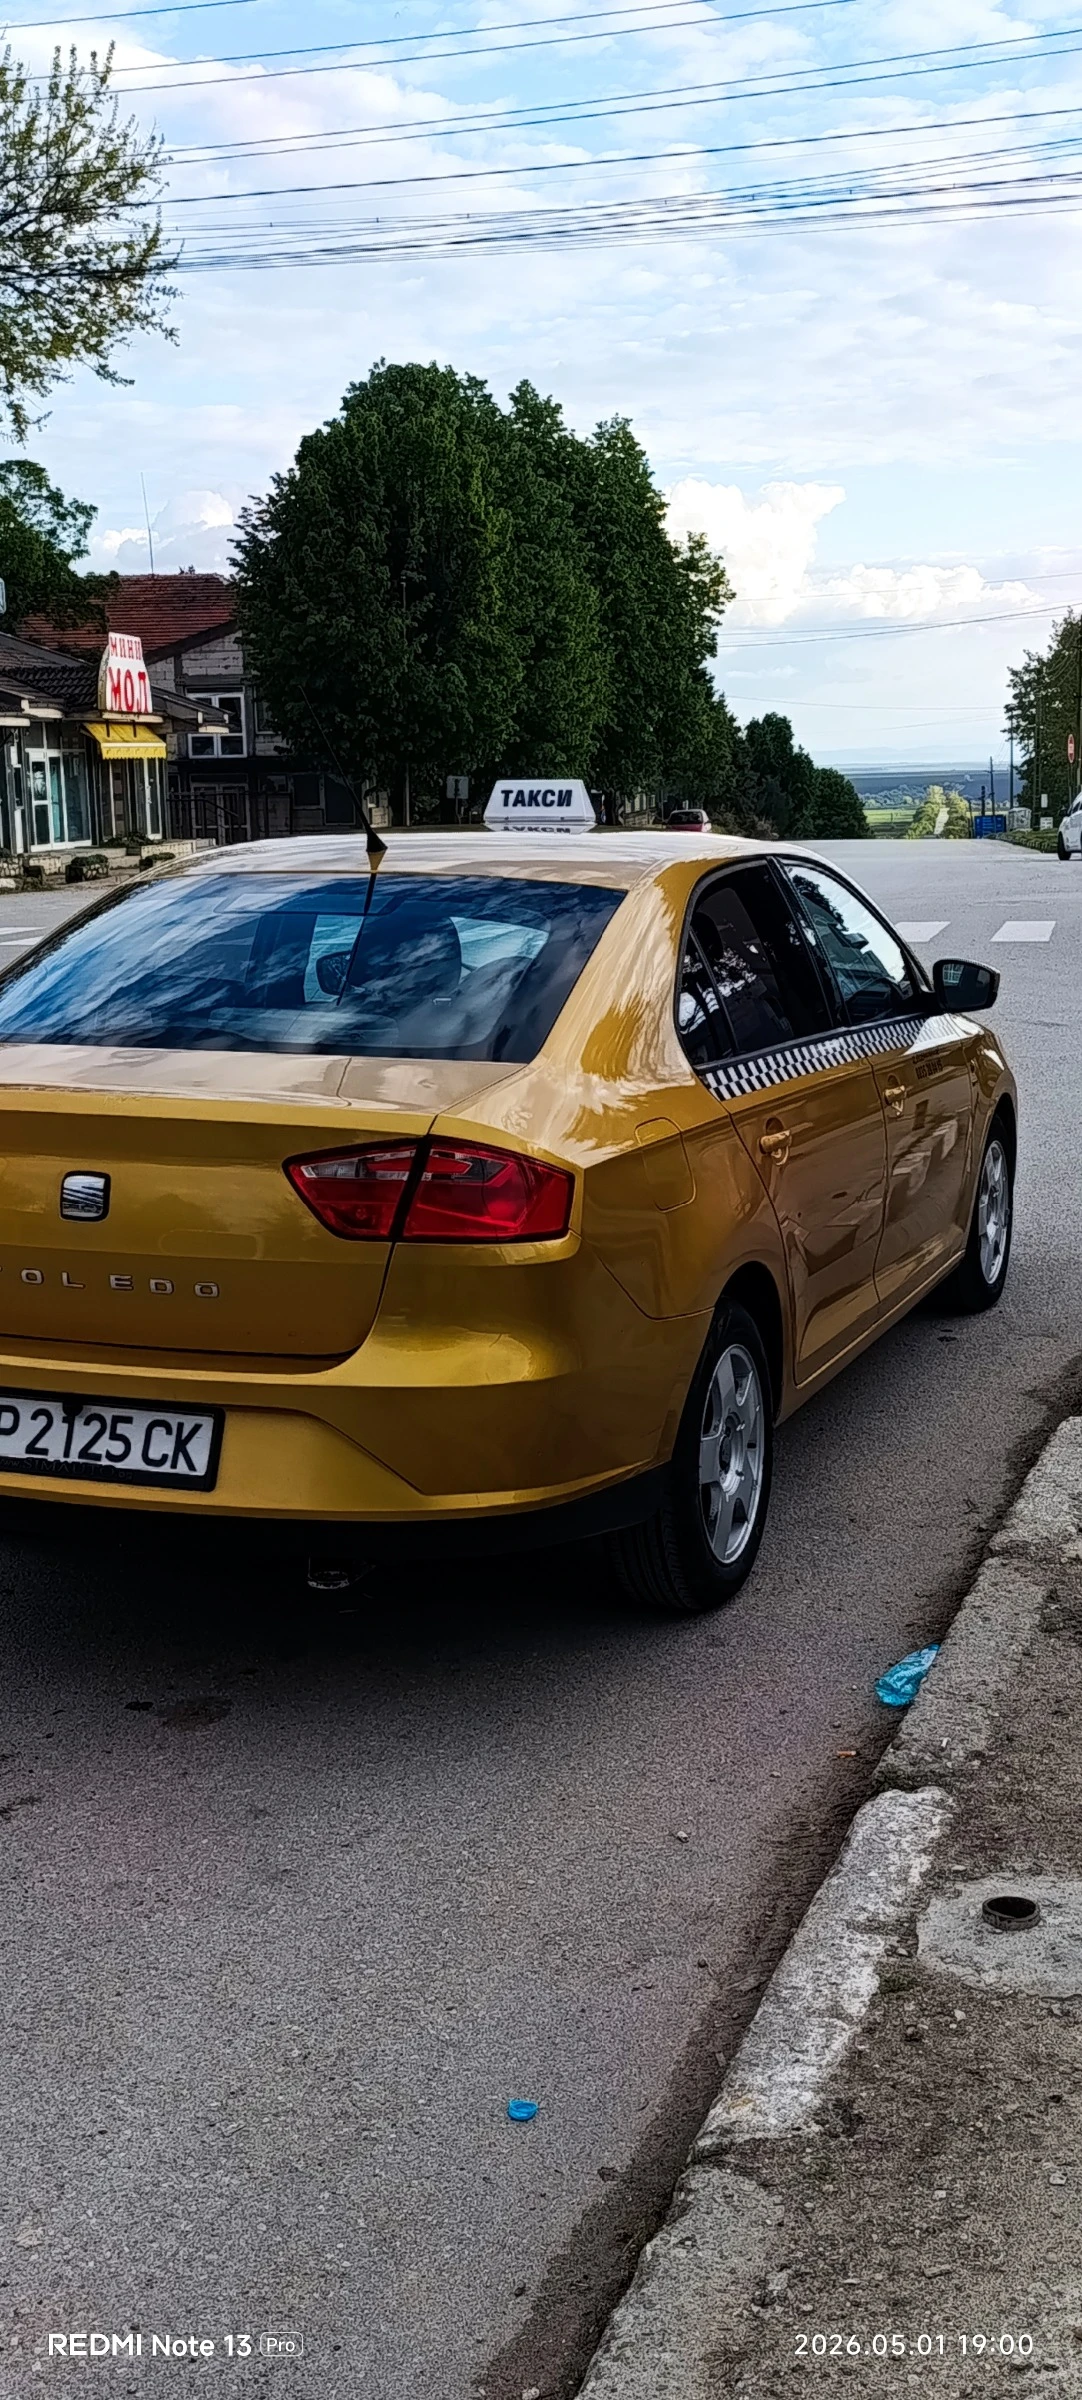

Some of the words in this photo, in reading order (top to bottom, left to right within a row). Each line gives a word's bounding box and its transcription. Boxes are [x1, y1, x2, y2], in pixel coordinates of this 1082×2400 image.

[109, 637, 143, 660] МИНИ
[108, 667, 148, 713] МОЛ
[501, 789, 573, 807] ТАКСИ
[0, 1267, 219, 1297] OLEDO
[25, 1408, 133, 1463] 2125
[141, 1419, 203, 1472] CK
